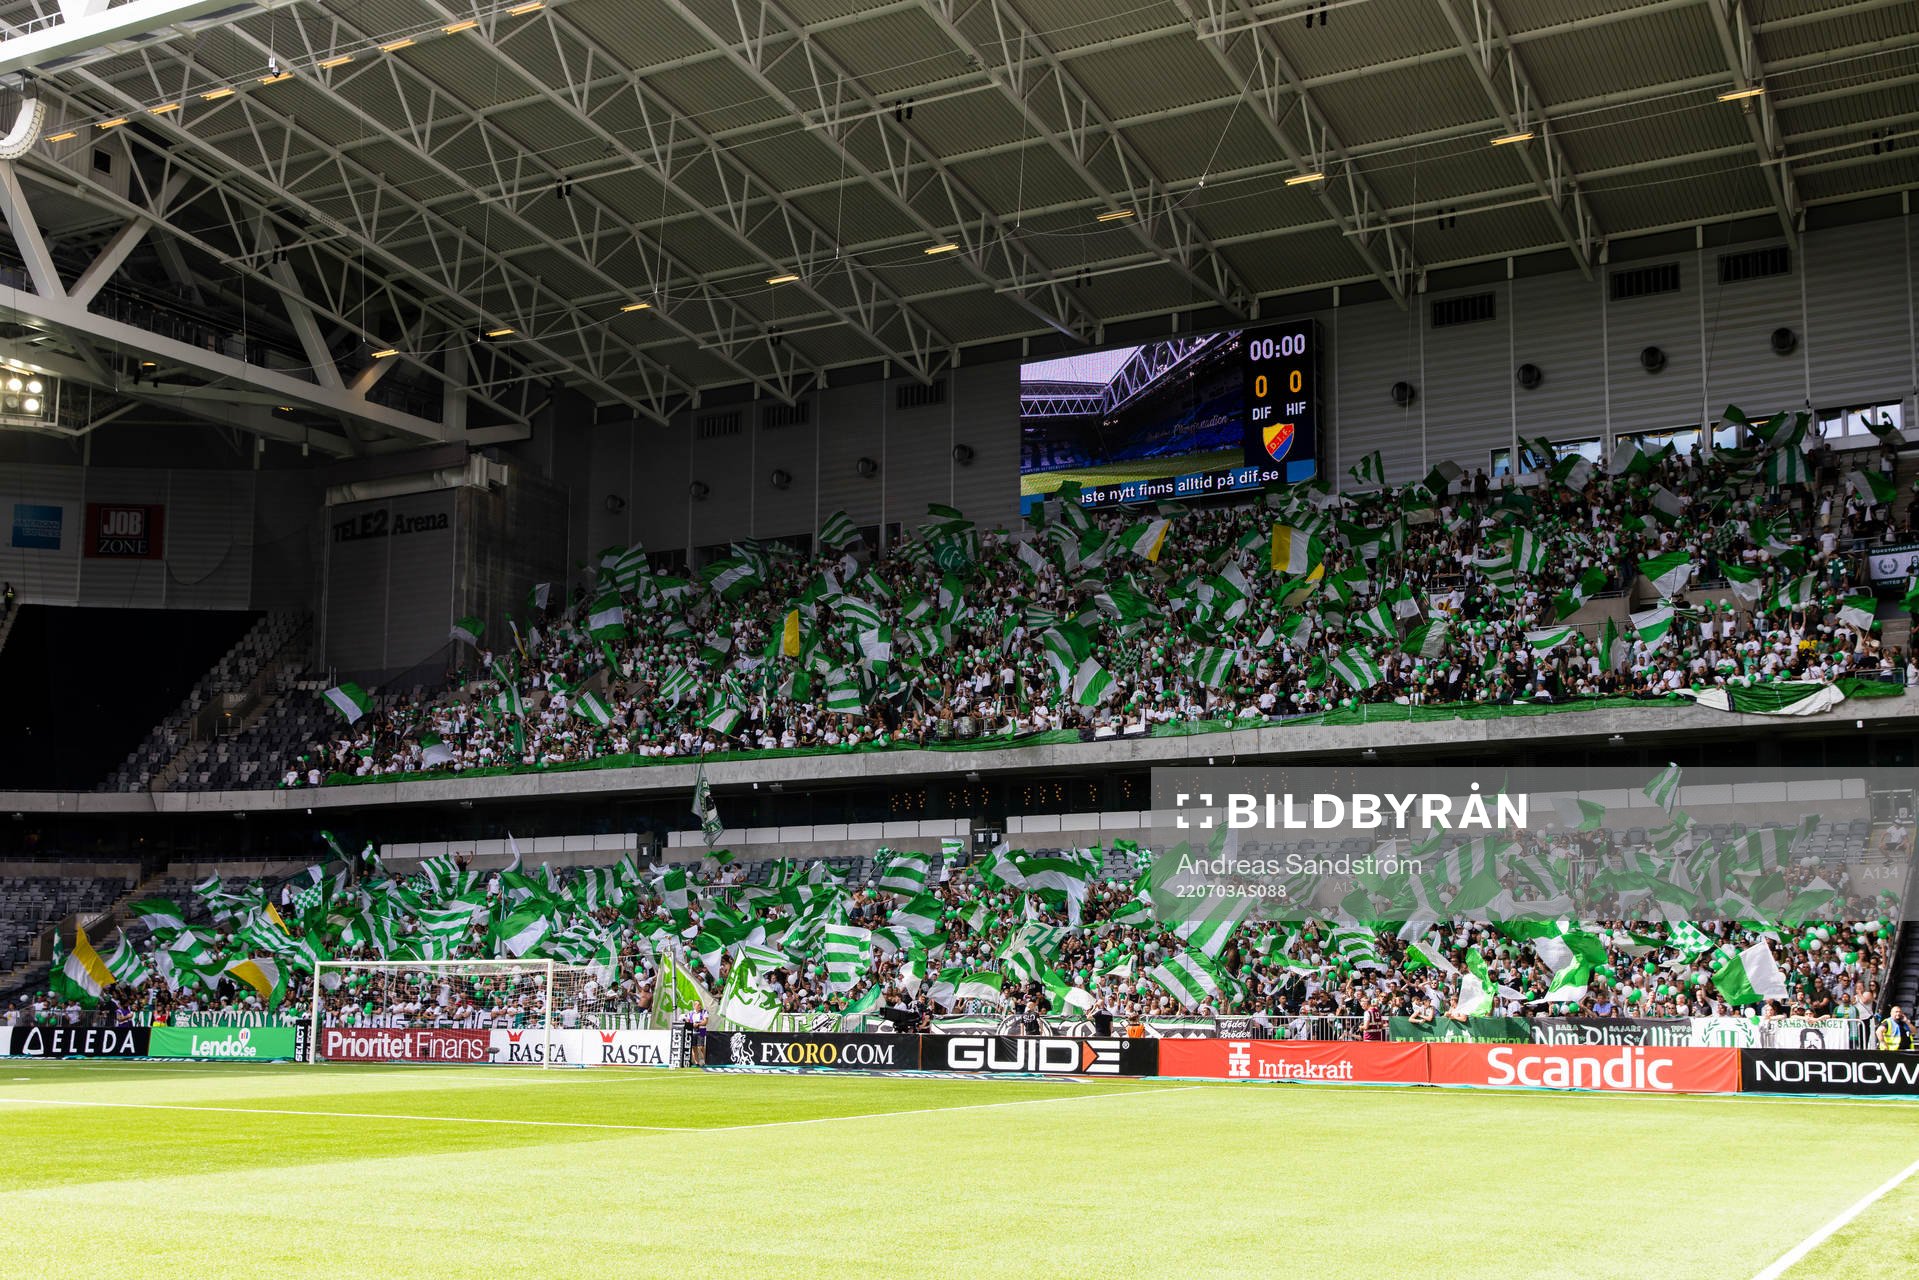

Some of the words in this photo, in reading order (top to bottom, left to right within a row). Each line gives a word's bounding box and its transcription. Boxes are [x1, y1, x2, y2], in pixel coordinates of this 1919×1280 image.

[1250, 333, 1305, 361] 00:00
[1255, 375, 1267, 398] 0
[1290, 370, 1302, 393] 0
[1252, 406, 1272, 420] DIF
[1286, 401, 1306, 416] HIF
[1109, 487, 1135, 503] nytt
[1139, 482, 1174, 498] finns
[1177, 475, 1213, 493] alltid
[1217, 473, 1234, 490] på
[1239, 468, 1279, 486] dif.se
[103, 511, 143, 536] JOB
[334, 508, 389, 542] TELE2
[392, 513, 449, 535] Arena
[98, 539, 149, 555] ZONE
[1863, 866, 1899, 879] A134
[52, 1029, 135, 1053] ELEDA
[295, 1025, 305, 1062] SELECT
[327, 1031, 413, 1059] Prioritet
[417, 1033, 484, 1059] Finans
[602, 1045, 664, 1064] RASTA
[760, 1043, 895, 1064] FXORO.COM
[1258, 1059, 1353, 1079] Infrakraft
[1487, 1047, 1673, 1089] Scandic
